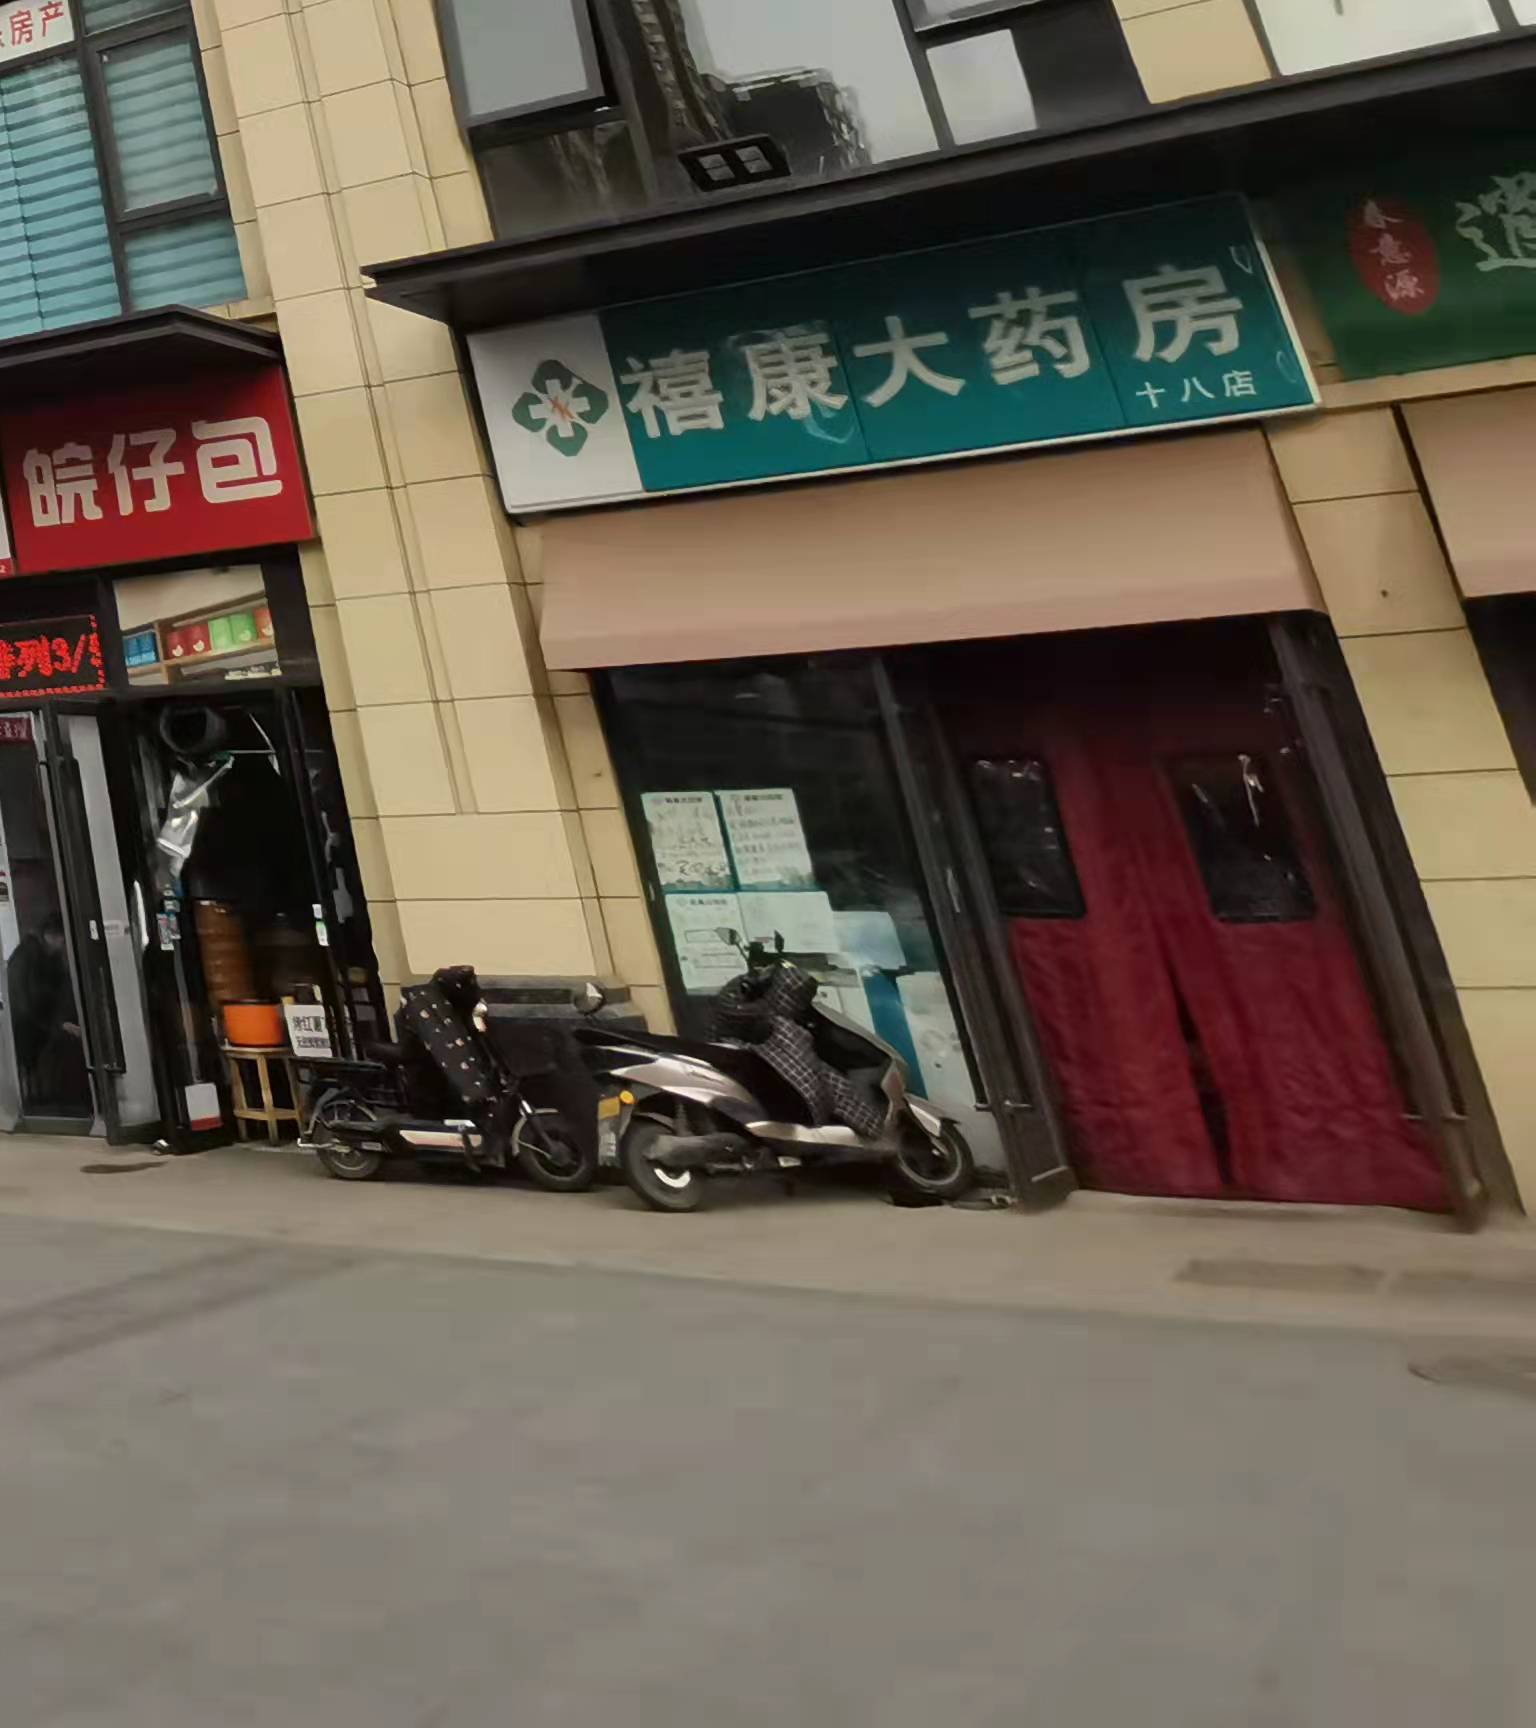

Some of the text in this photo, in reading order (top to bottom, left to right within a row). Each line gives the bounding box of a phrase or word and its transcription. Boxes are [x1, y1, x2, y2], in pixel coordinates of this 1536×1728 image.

[620, 262, 1245, 439] 禧康大药房
[1135, 370, 1257, 409] 十八店
[23, 416, 283, 528] 皖仔包
